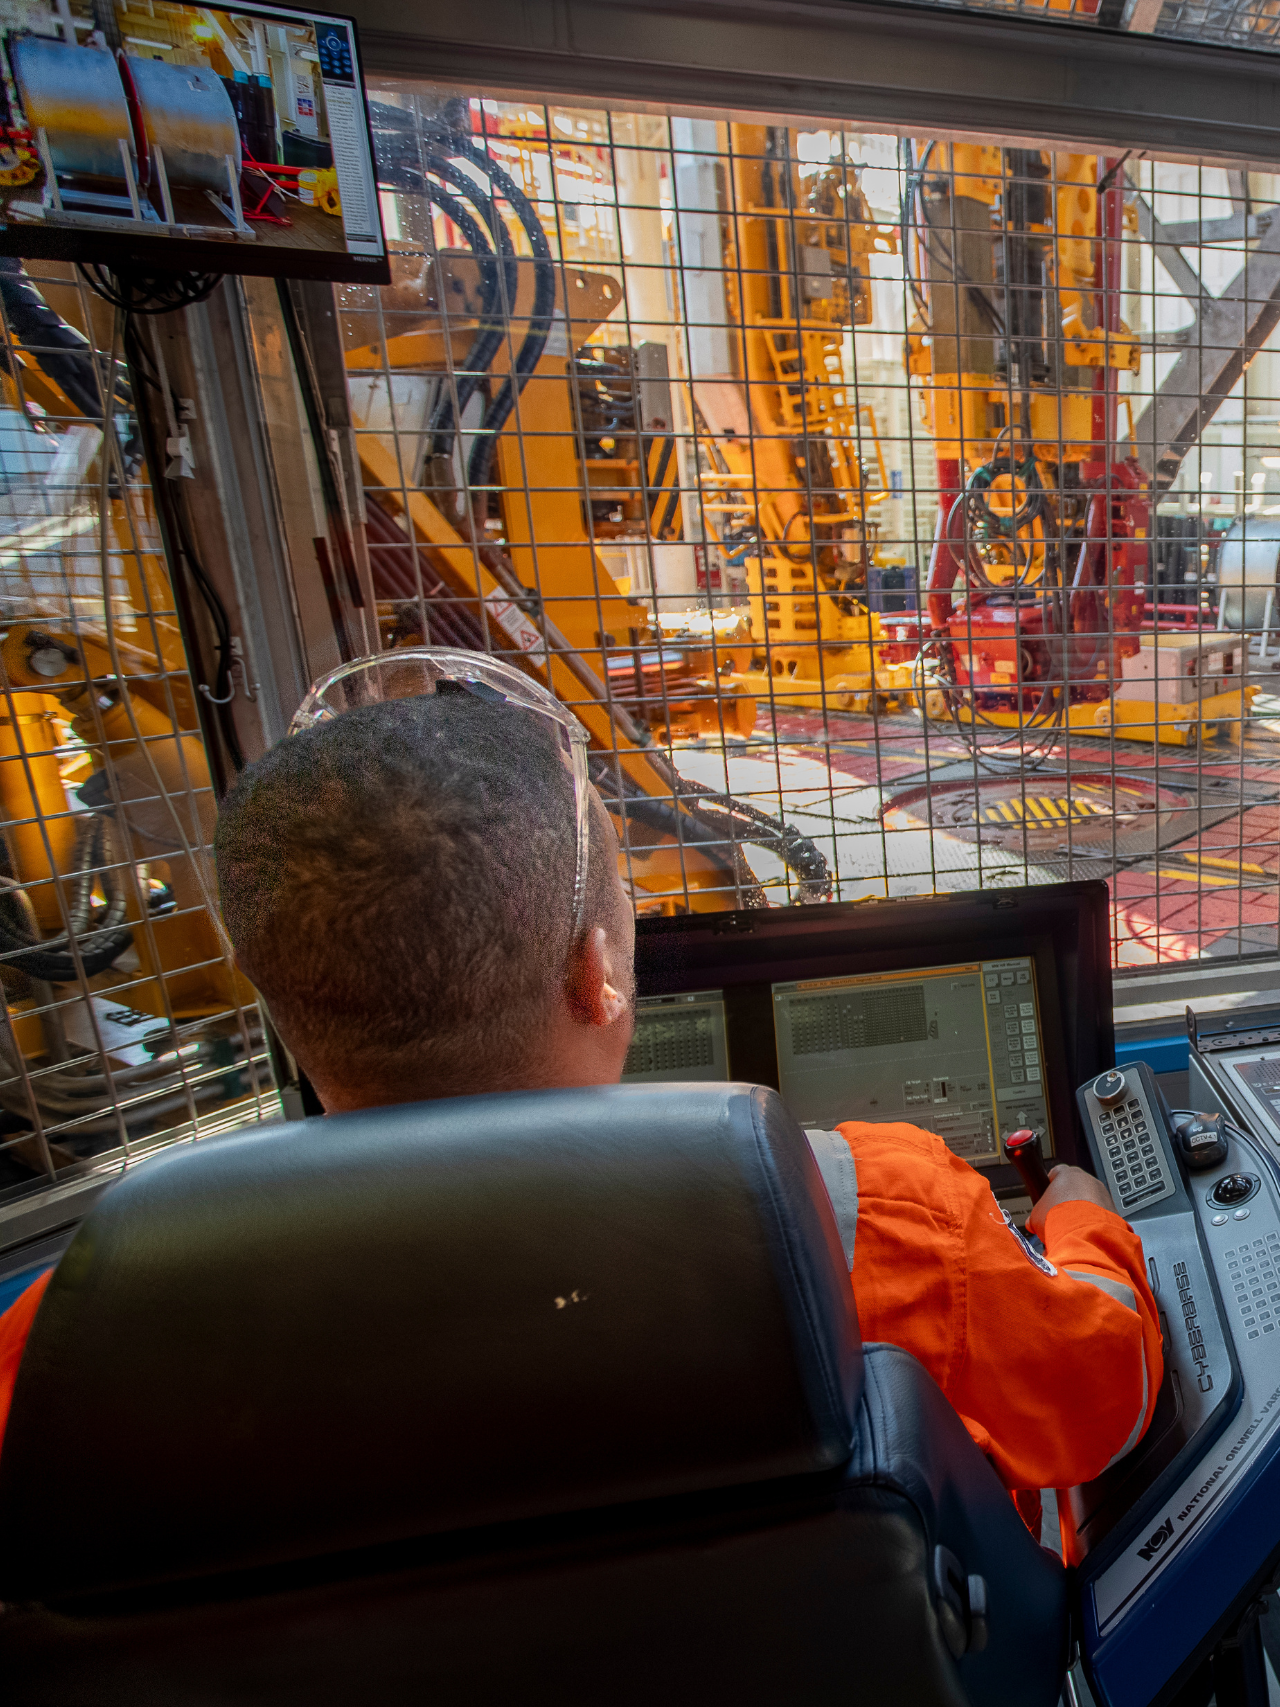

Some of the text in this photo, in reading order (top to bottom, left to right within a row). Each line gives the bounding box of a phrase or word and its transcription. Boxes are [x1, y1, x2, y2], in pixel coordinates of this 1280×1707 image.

[1173, 1261, 1214, 1393] CYBERBASE
[1137, 1516, 1175, 1561] NOV
[1177, 1463, 1228, 1521] NATIONAL
[1226, 1416, 1263, 1462] OILWELL
